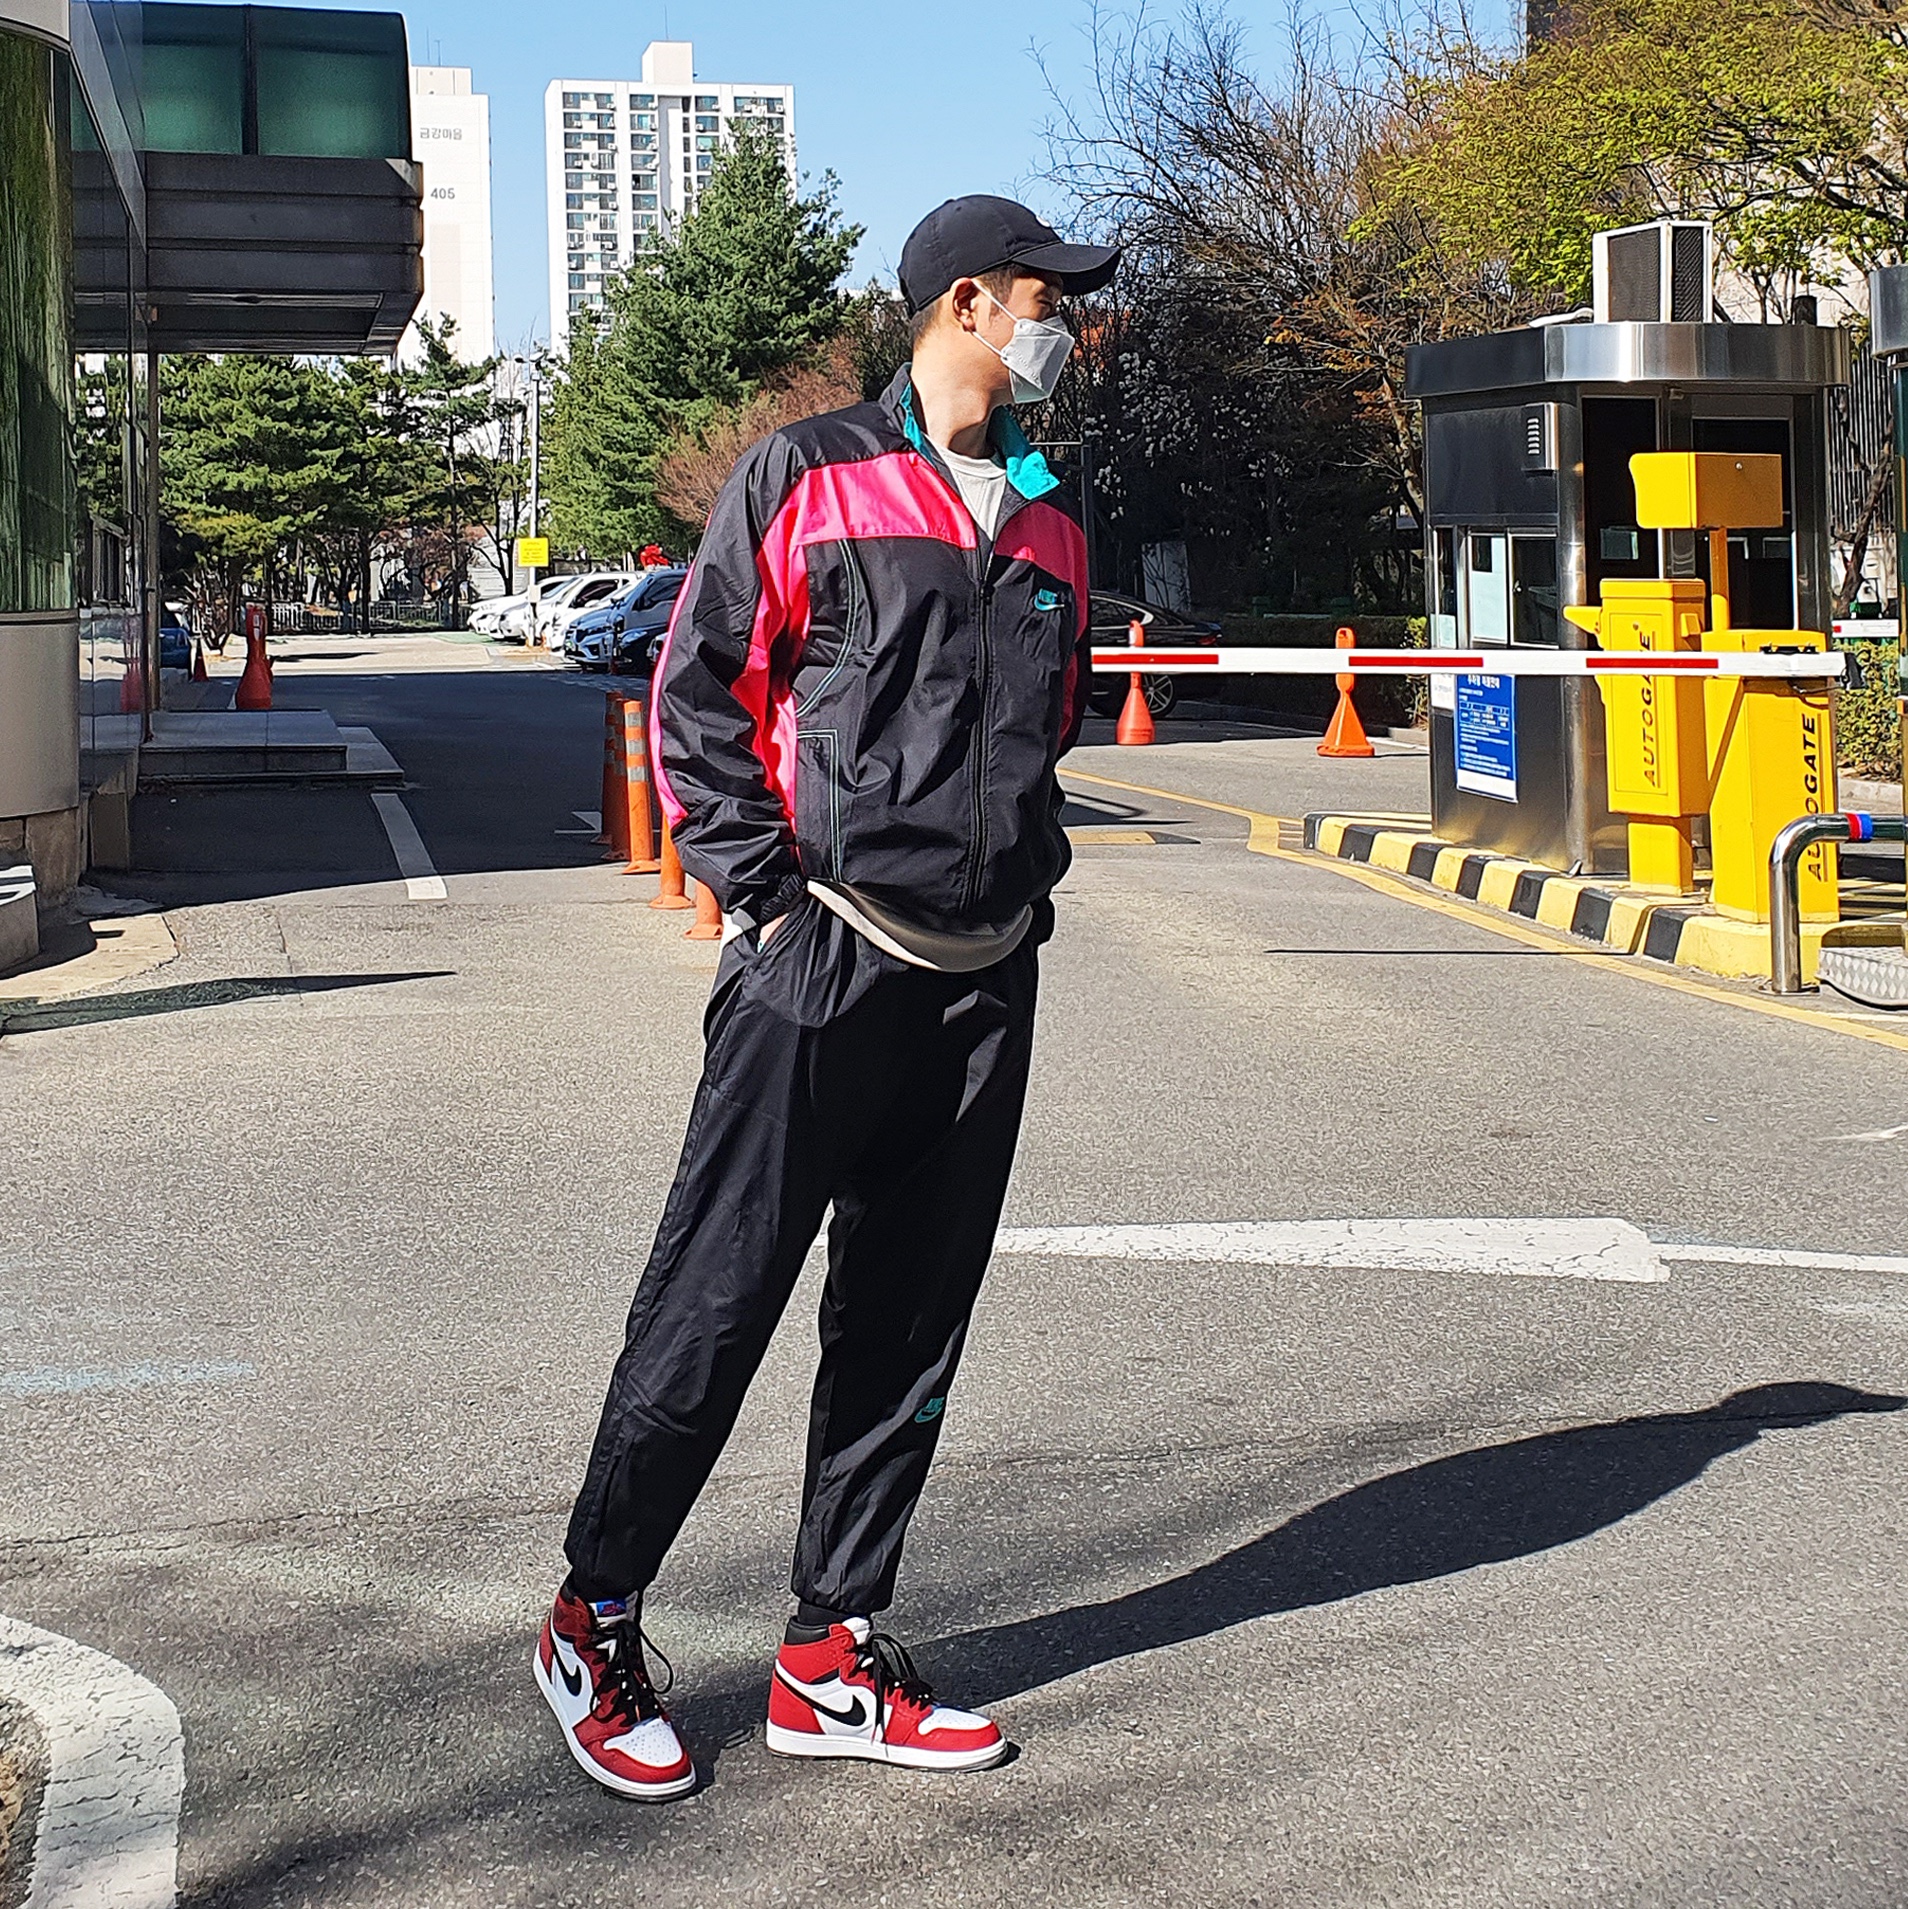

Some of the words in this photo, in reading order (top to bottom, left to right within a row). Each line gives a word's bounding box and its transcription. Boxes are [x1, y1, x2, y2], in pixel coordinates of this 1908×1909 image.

[430, 187, 456, 200] 405
[1639, 630, 1656, 788] AUTOGE
[1802, 713, 1822, 882] AUOGATE
